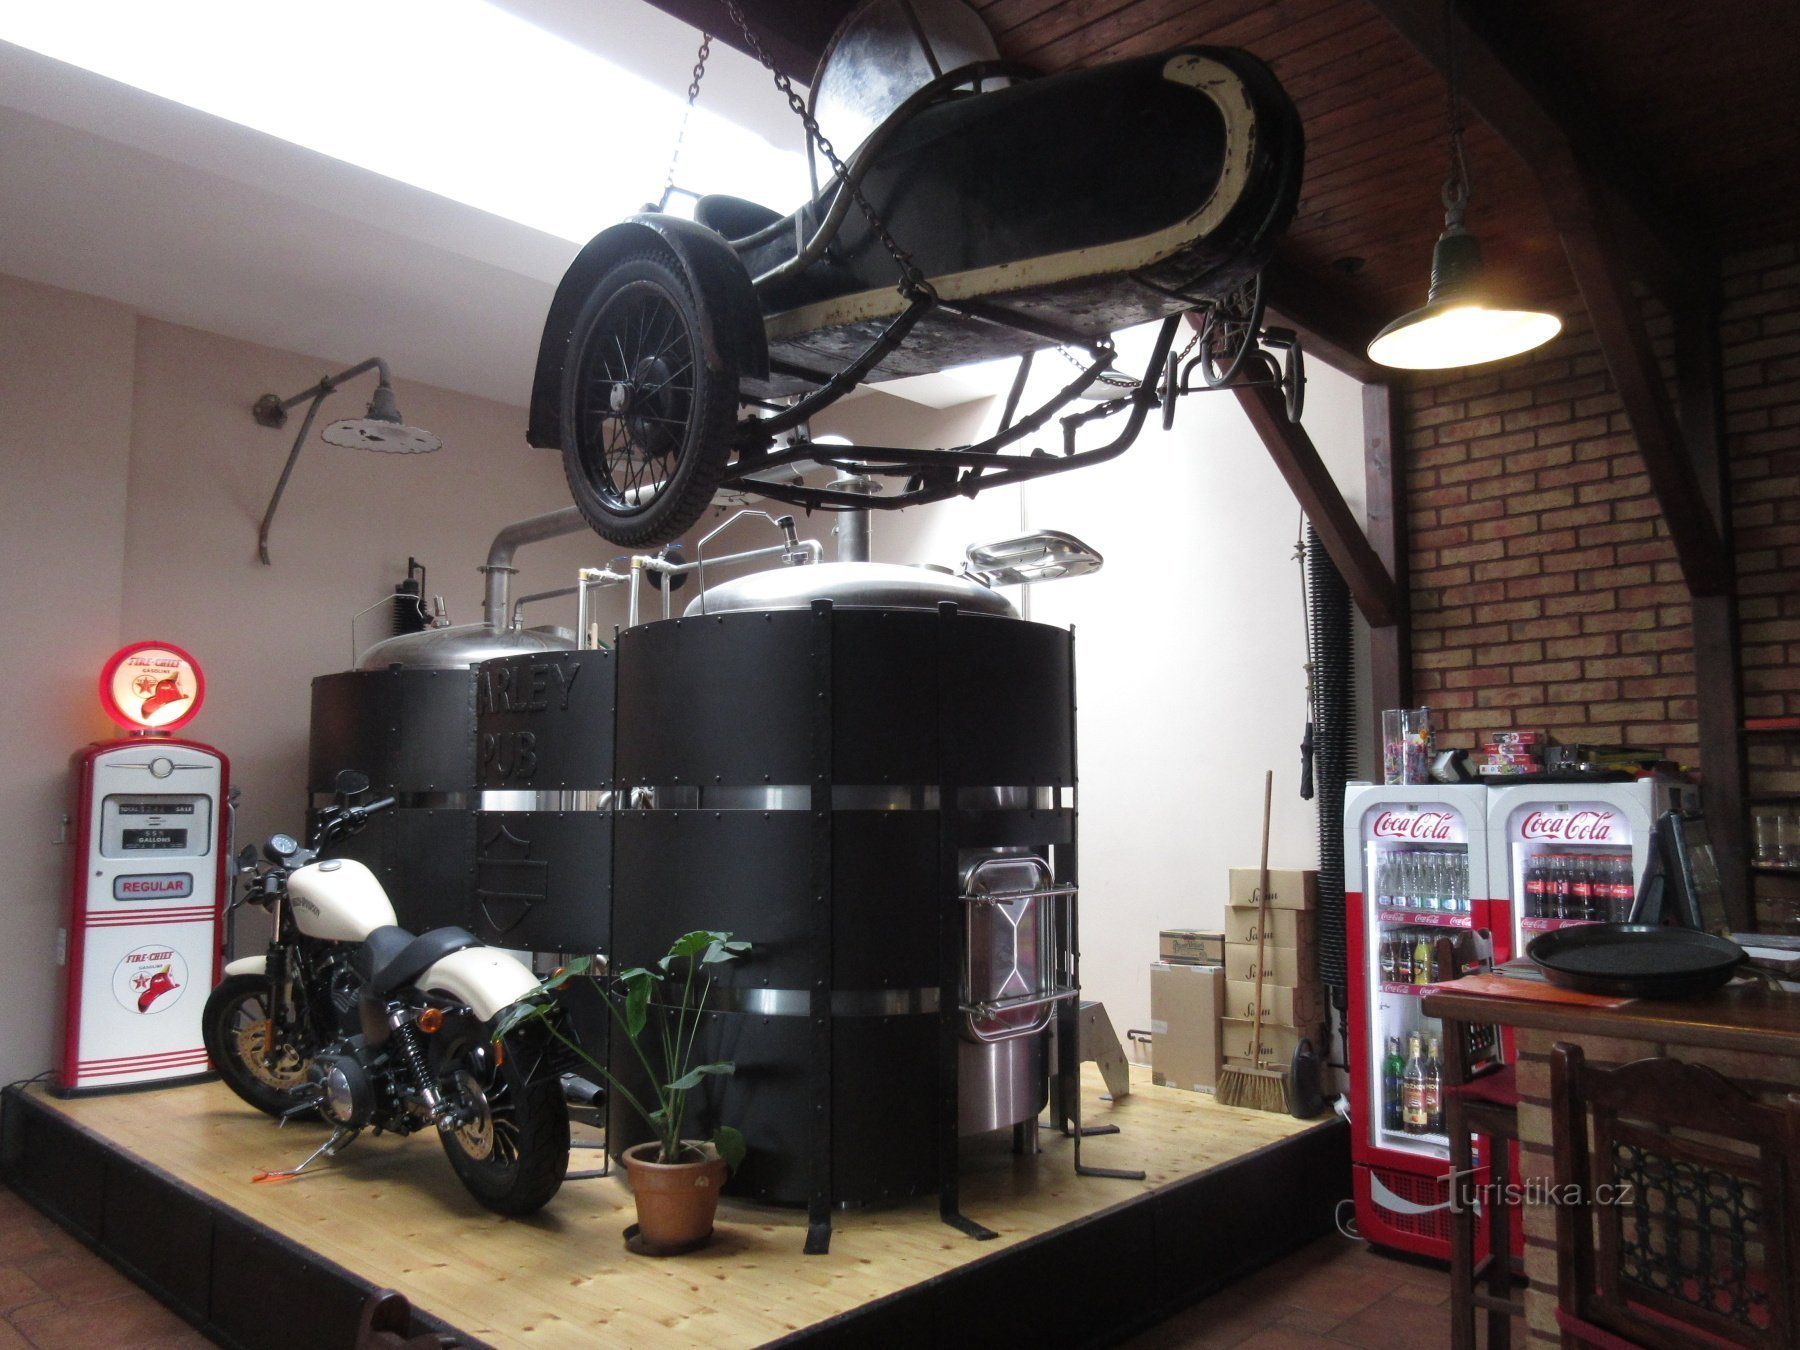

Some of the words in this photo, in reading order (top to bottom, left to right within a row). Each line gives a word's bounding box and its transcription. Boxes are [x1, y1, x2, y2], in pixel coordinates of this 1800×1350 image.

[1373, 811, 1454, 840] Coca-Cola
[1521, 811, 1617, 840] Coca-Cola
[122, 880, 184, 892] REGULAR
[1245, 926, 1273, 942] Sam
[126, 951, 174, 963] FIRE-CHIEF
[1245, 963, 1273, 980] Sam
[1243, 1002, 1271, 1018] Sam
